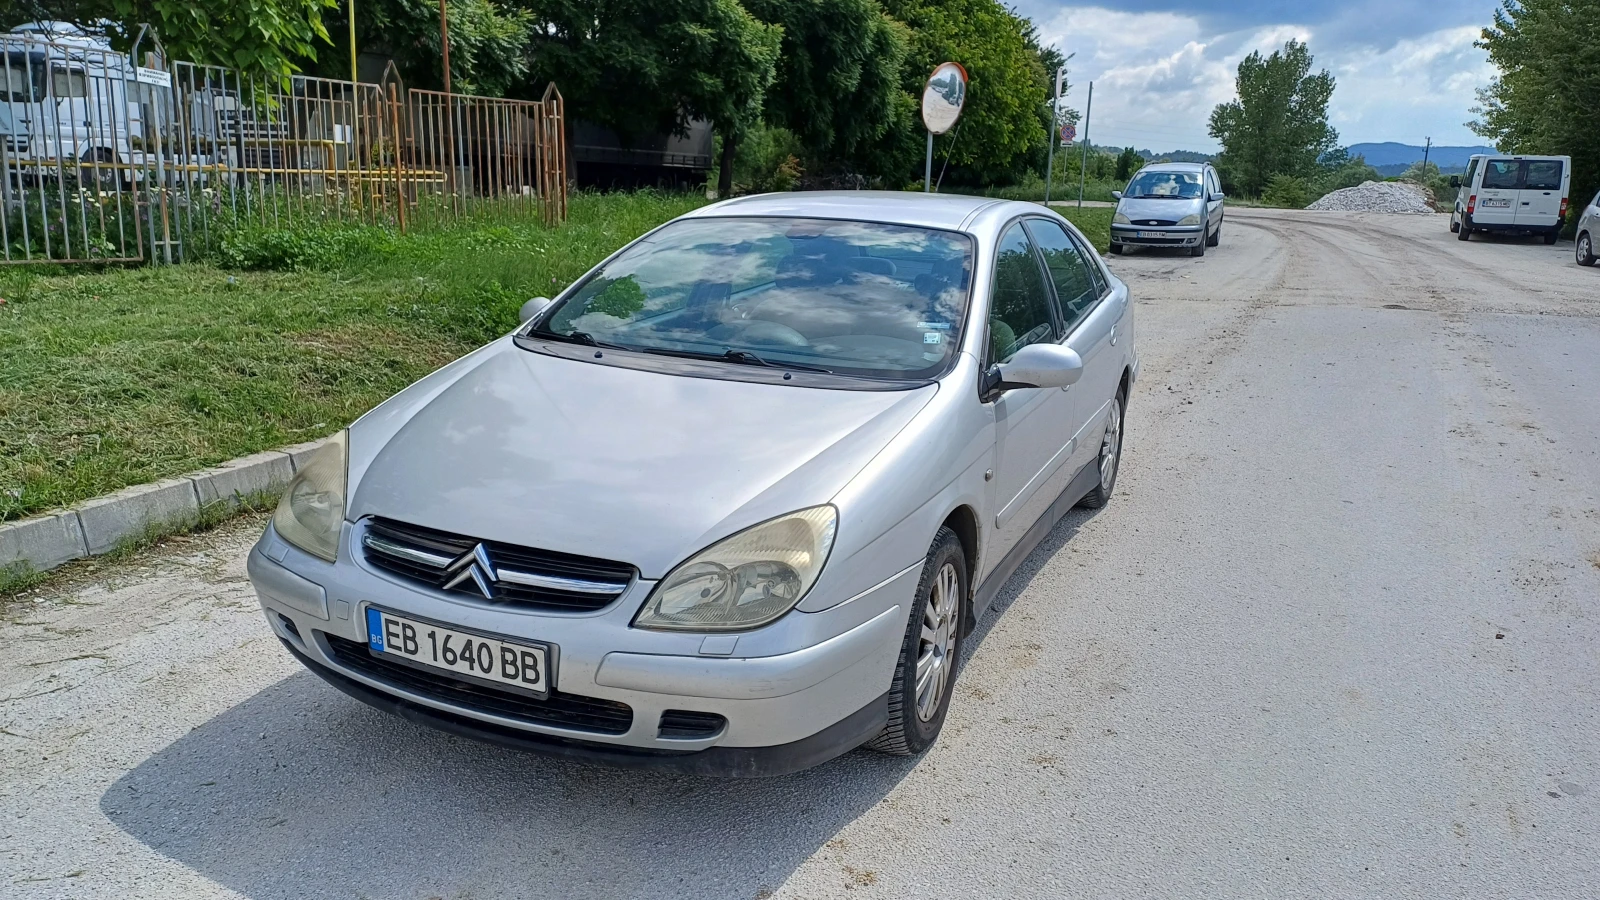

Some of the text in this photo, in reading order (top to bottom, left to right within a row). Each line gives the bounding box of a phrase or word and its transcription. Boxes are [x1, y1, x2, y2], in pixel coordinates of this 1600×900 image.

[371, 634, 383, 645] BG
[385, 617, 540, 685] EB 1640 BB
